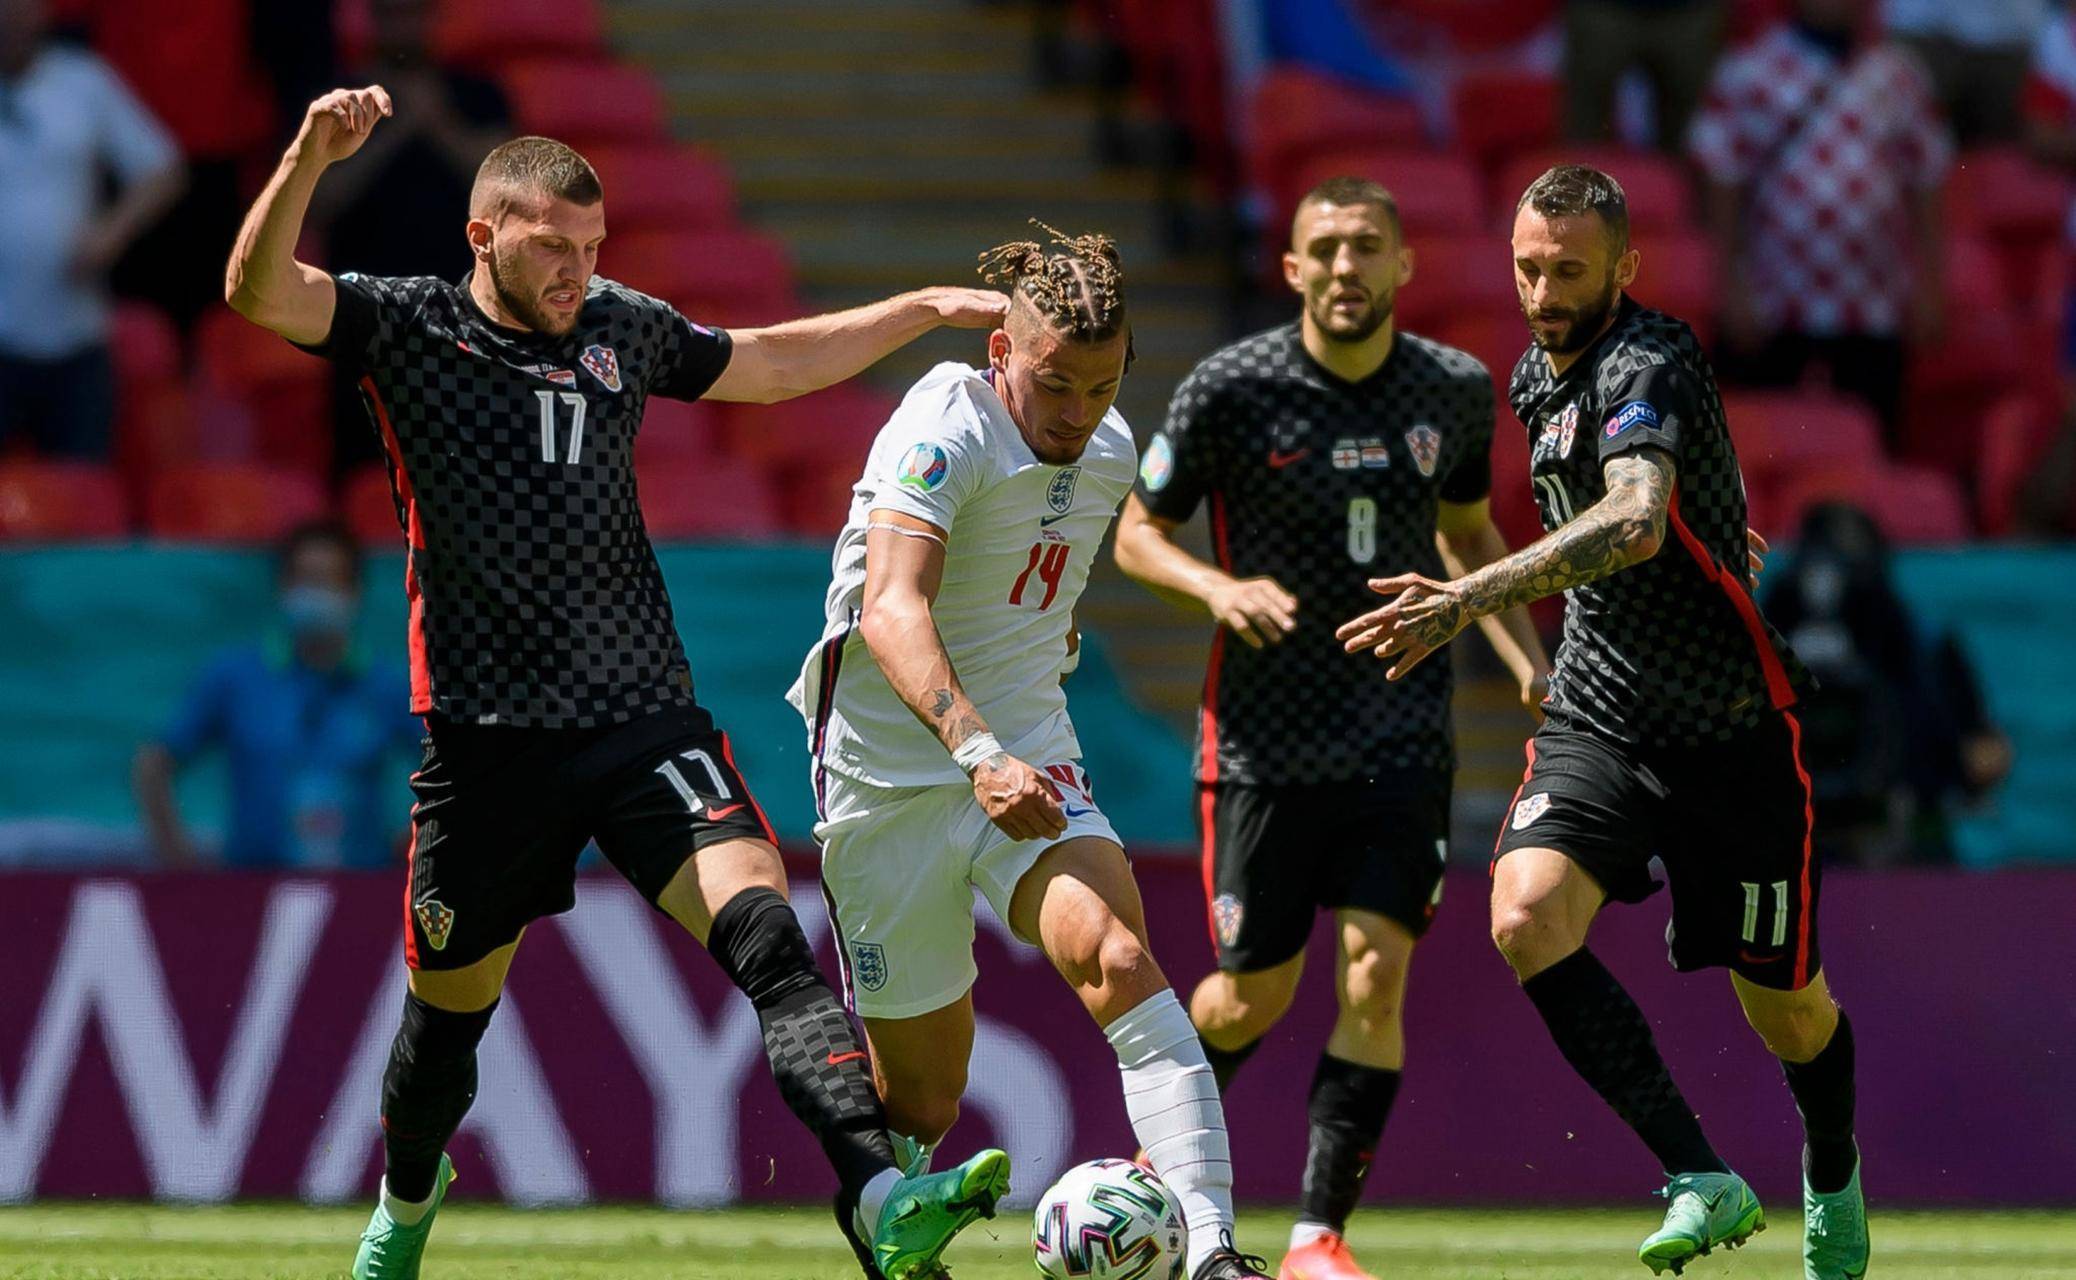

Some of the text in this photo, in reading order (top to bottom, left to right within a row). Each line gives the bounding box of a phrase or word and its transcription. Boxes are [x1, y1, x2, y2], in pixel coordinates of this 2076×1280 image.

[534, 390, 587, 464] 17
[1618, 404, 1657, 426] RESPECT
[1347, 498, 1378, 565] 8
[1534, 473, 1575, 529] 11
[1008, 542, 1071, 611] 14
[654, 748, 732, 812] 17
[1740, 880, 1788, 946] 11
